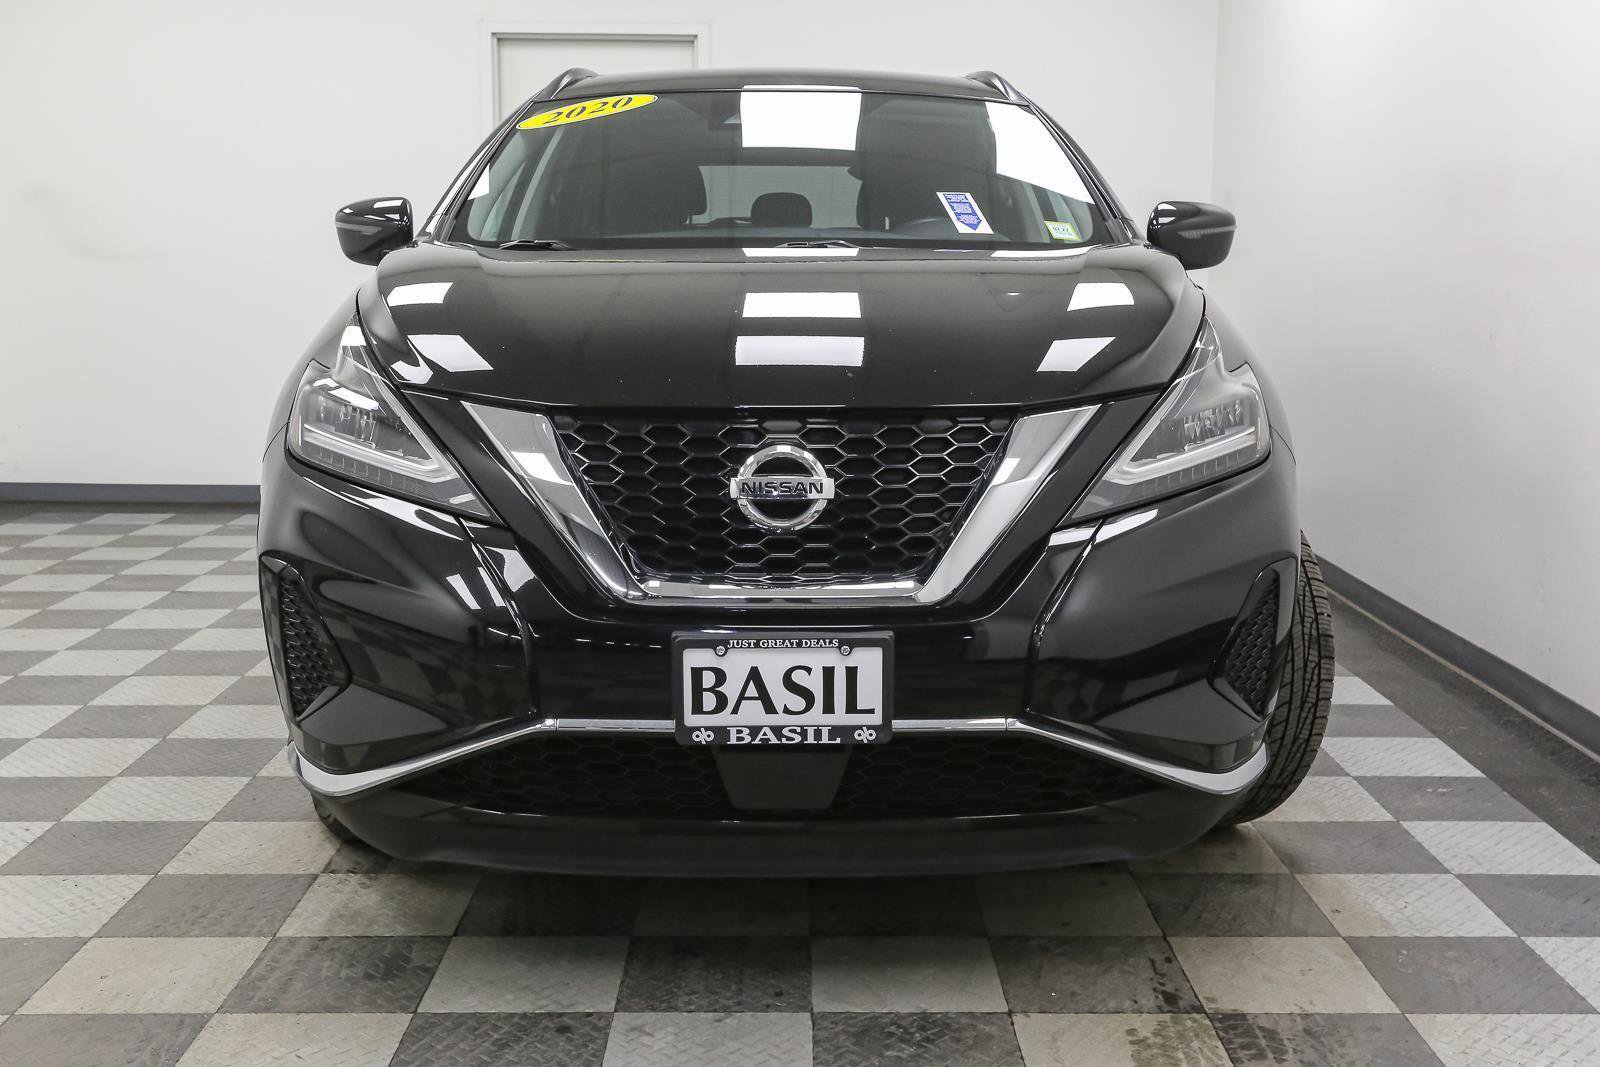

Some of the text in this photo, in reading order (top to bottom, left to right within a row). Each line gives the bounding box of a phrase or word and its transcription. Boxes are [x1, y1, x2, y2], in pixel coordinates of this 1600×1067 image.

[543, 97, 632, 124] 2020
[741, 481, 824, 494] NISSAN
[728, 639, 839, 648] JUST GREAT DEALS
[691, 665, 875, 715] BASIL
[727, 726, 841, 744] BASIL
